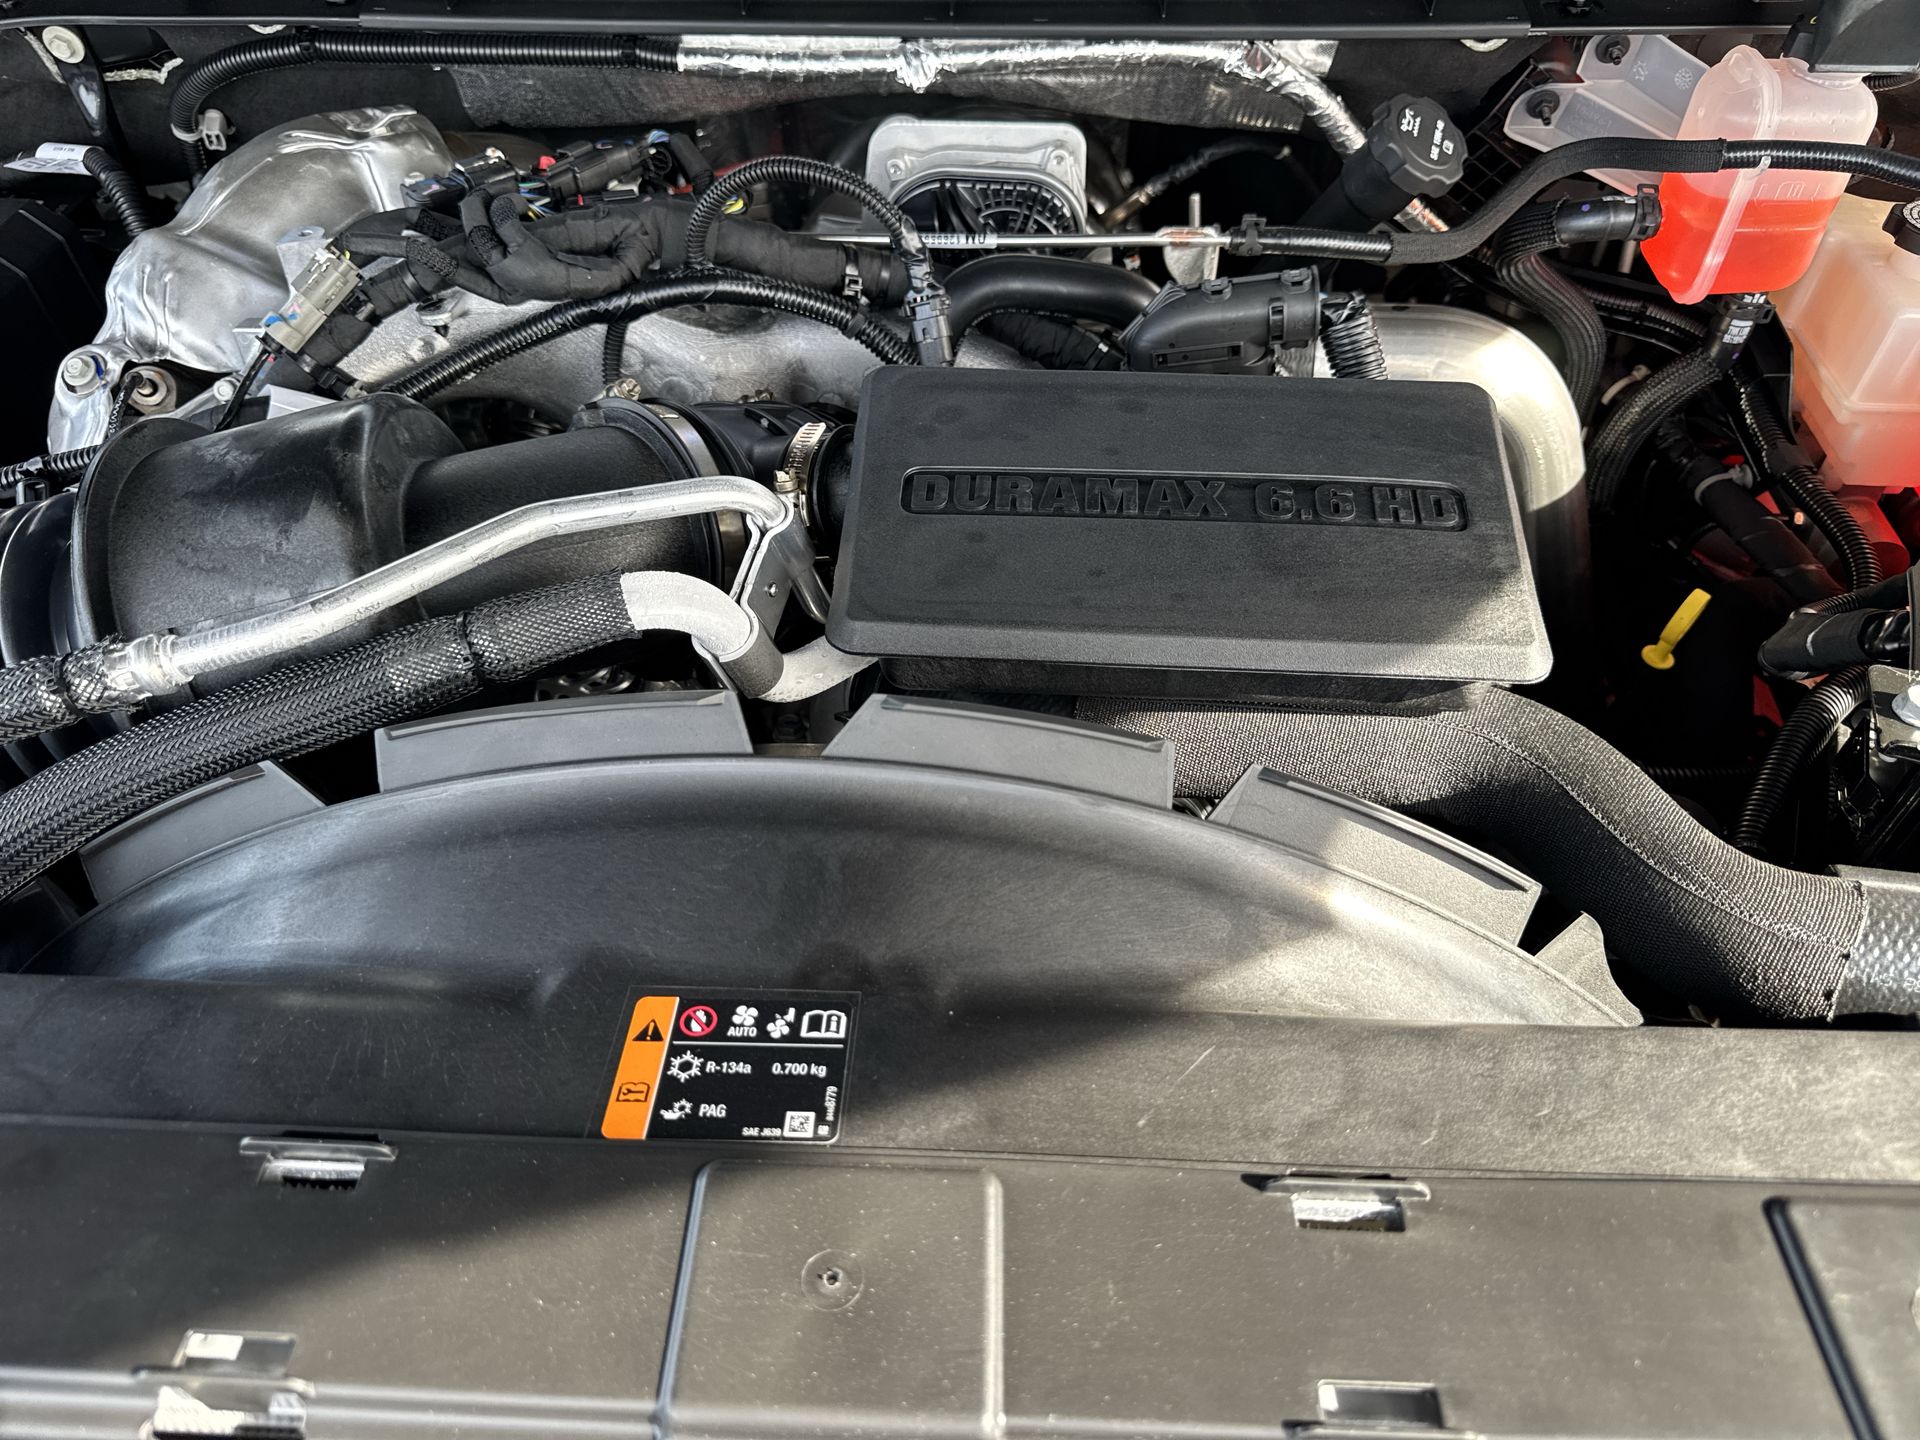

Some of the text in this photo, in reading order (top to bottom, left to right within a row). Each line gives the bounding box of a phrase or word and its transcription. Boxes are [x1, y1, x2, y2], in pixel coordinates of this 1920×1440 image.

[911, 474, 1459, 527] DURAMAX 6.6 HD
[727, 1026, 757, 1037] AUTO
[705, 1062, 827, 1078] R-134a 0.700 kg
[699, 1104, 727, 1118] PAG
[742, 1127, 760, 1136] SAE
